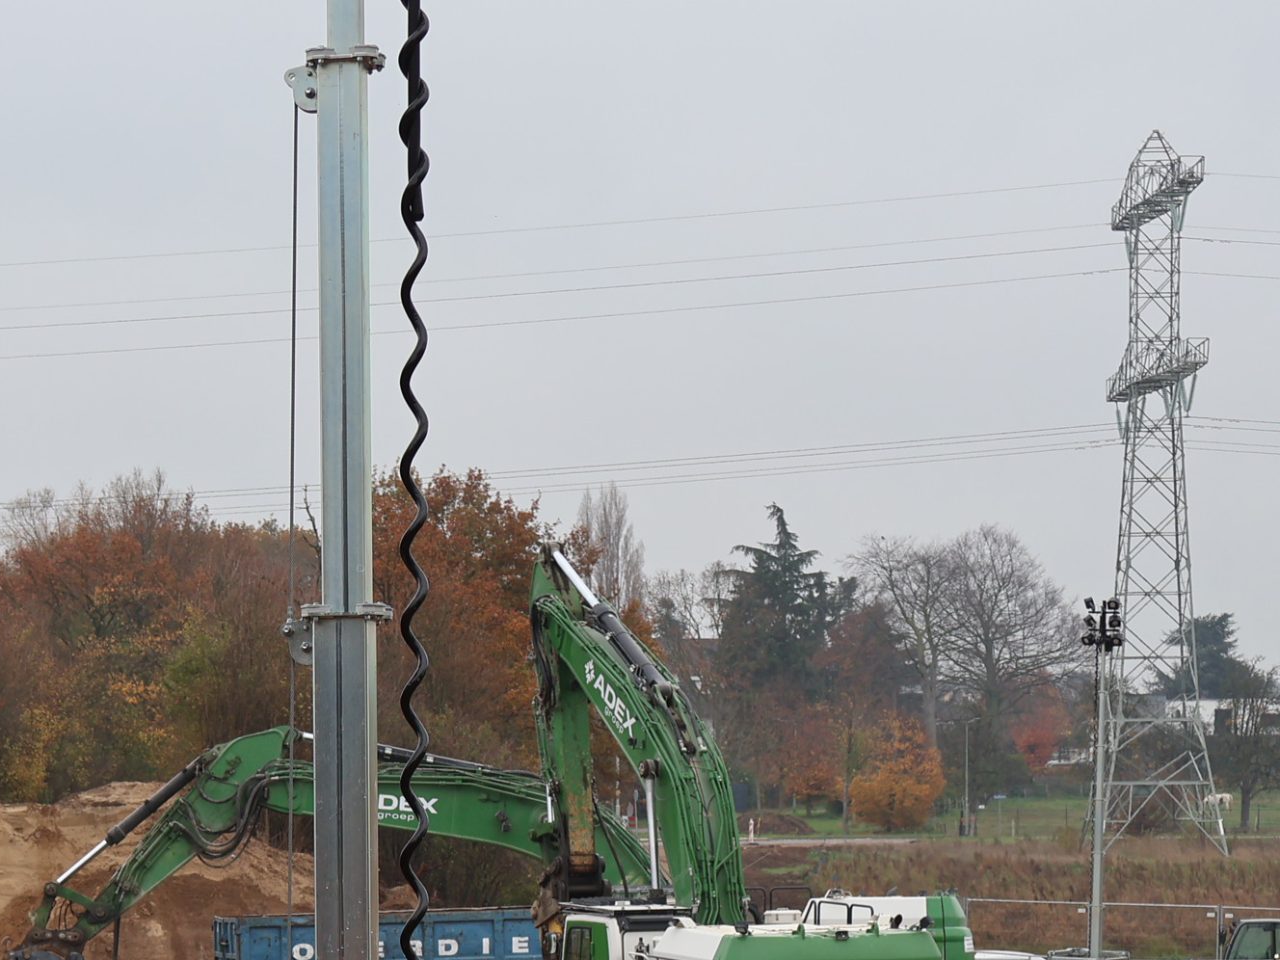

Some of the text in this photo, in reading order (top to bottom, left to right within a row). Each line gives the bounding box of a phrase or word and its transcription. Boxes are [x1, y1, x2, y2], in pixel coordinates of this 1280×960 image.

[593, 673, 636, 738] ADEX
[604, 706, 624, 734] groep
[378, 793, 439, 815] DEX
[377, 812, 415, 822] groep
[292, 936, 529, 960] ORDIE
